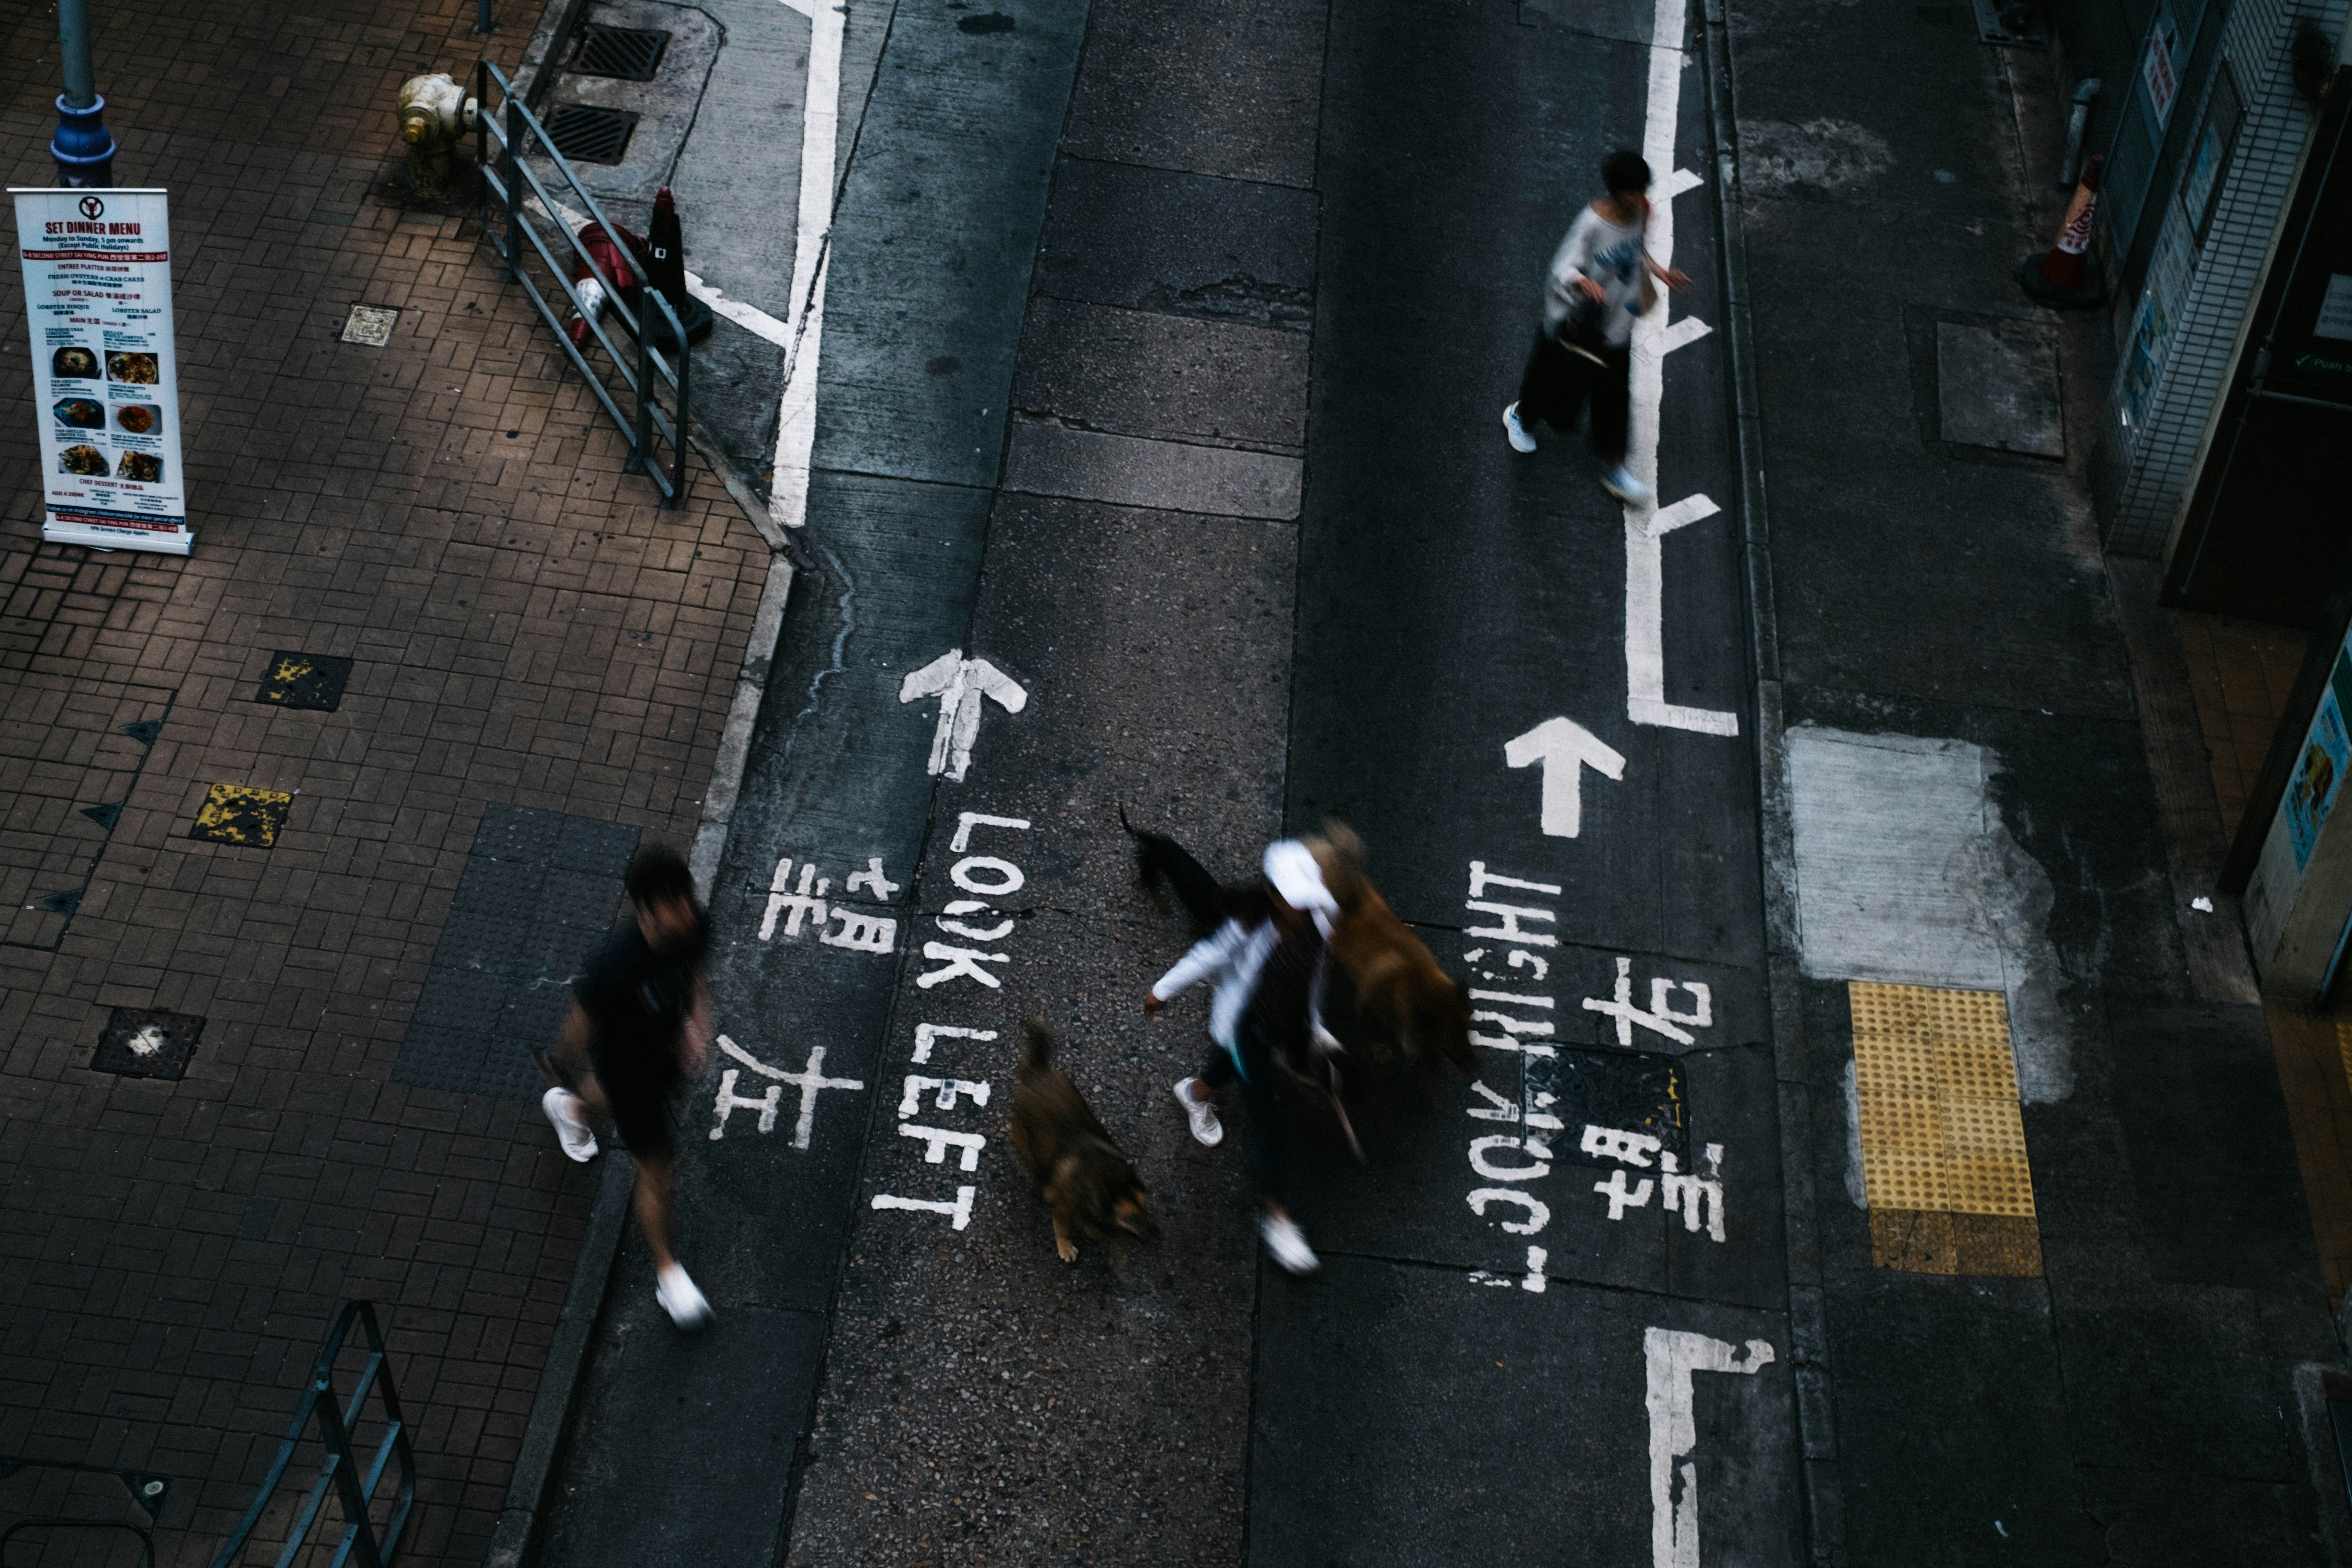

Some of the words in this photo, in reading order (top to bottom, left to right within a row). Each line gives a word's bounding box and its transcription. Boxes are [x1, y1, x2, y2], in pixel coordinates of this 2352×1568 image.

[45, 222, 63, 234] SET
[66, 222, 106, 234] DINNER
[109, 223, 140, 235] MENU
[916, 812, 1031, 989] LOOK
[871, 1023, 998, 1231] LEFT
